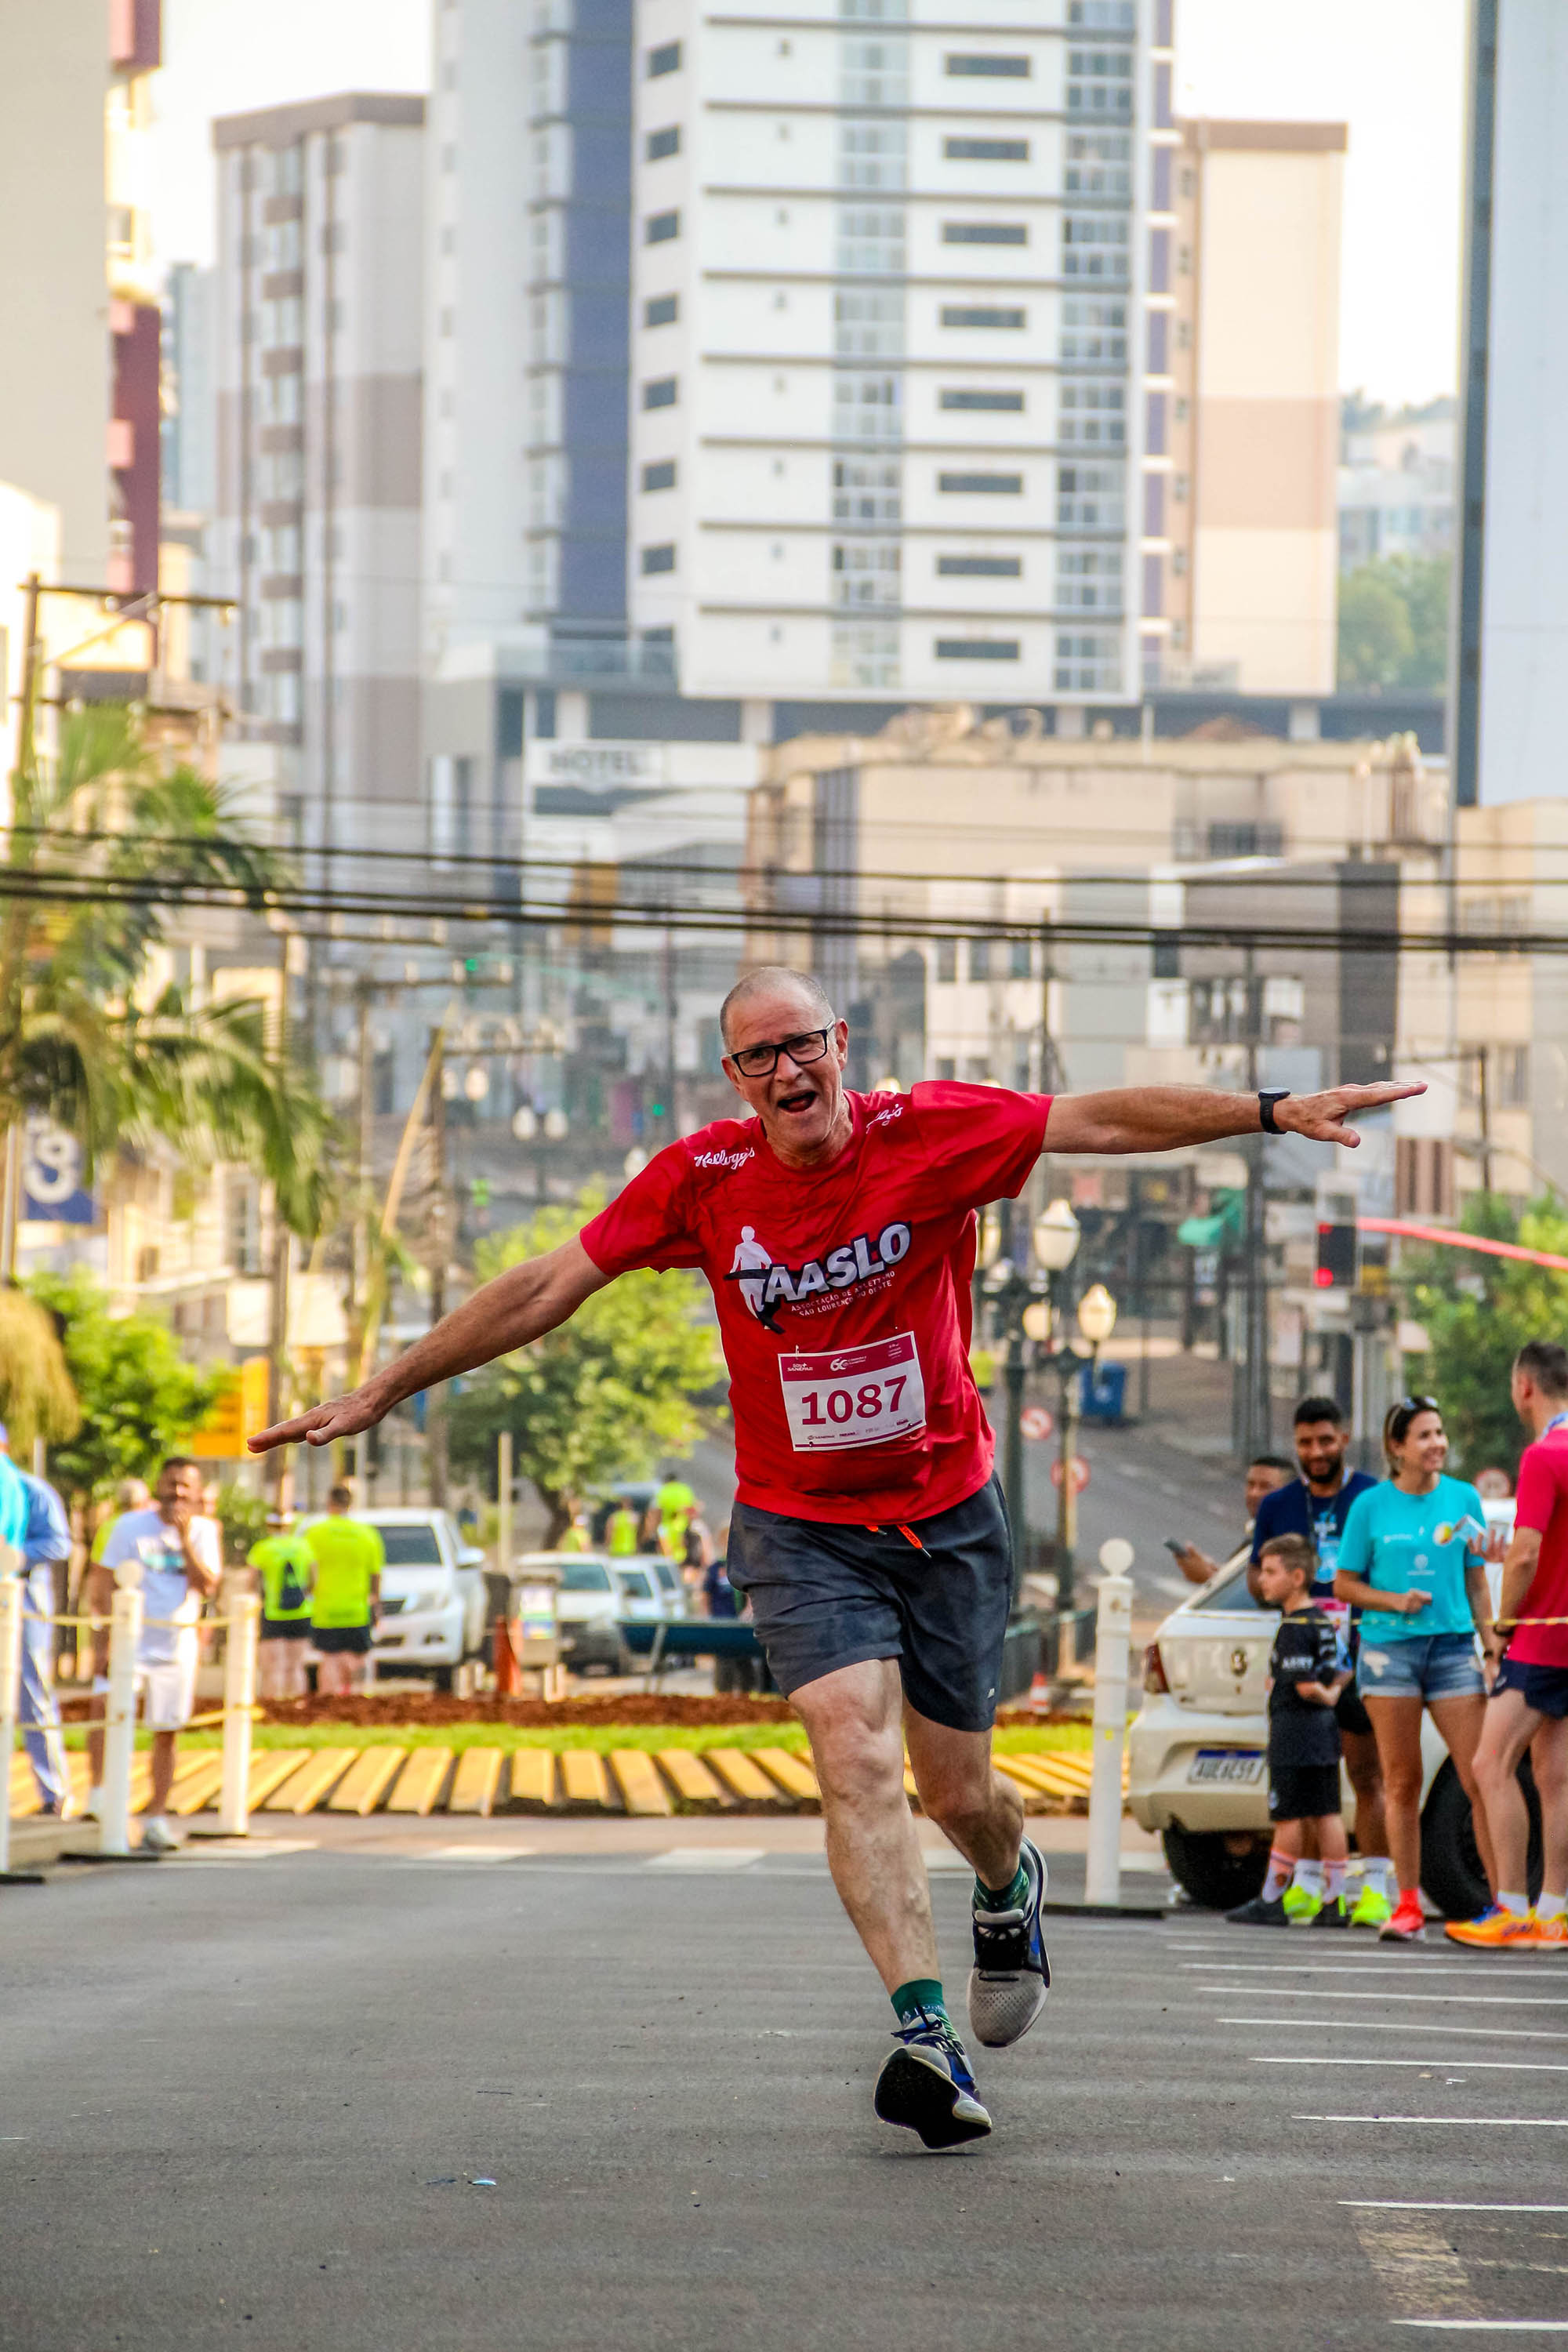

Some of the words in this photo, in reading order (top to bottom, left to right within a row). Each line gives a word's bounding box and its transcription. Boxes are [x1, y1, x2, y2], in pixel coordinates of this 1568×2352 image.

[549, 750, 642, 776] HOTEL
[694, 1147, 755, 1170] Kellogg's
[764, 1223, 911, 1303] AASLO
[868, 1279, 892, 1294] OETE
[801, 1375, 907, 1425] 1087
